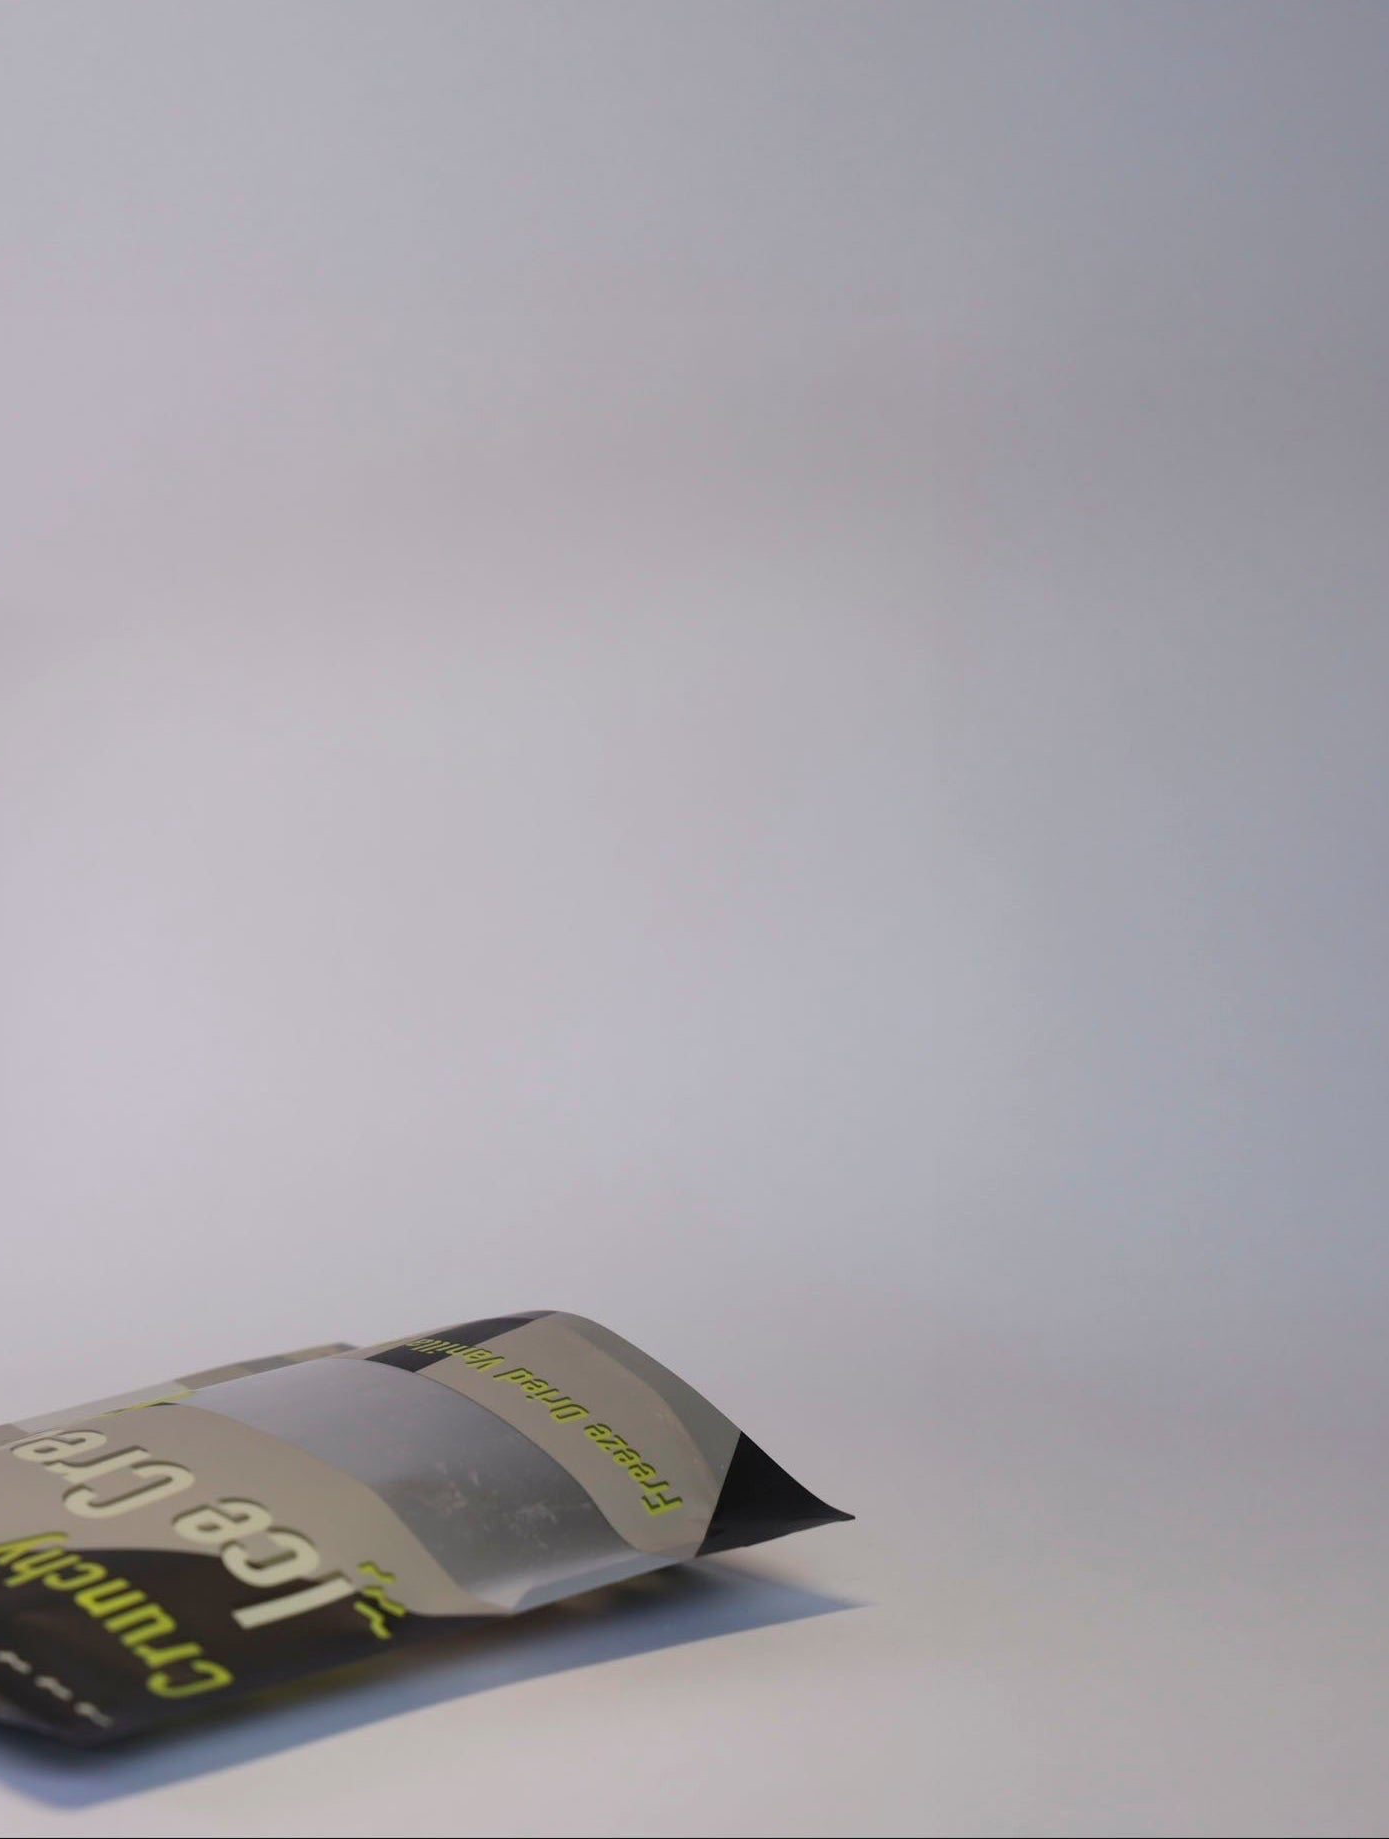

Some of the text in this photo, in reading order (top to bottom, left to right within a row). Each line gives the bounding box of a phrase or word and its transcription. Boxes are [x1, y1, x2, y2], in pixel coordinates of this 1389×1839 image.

[493, 1367, 590, 1424] Dried
[583, 1423, 683, 1516] Freeze
[172, 1497, 358, 1630] Ice
